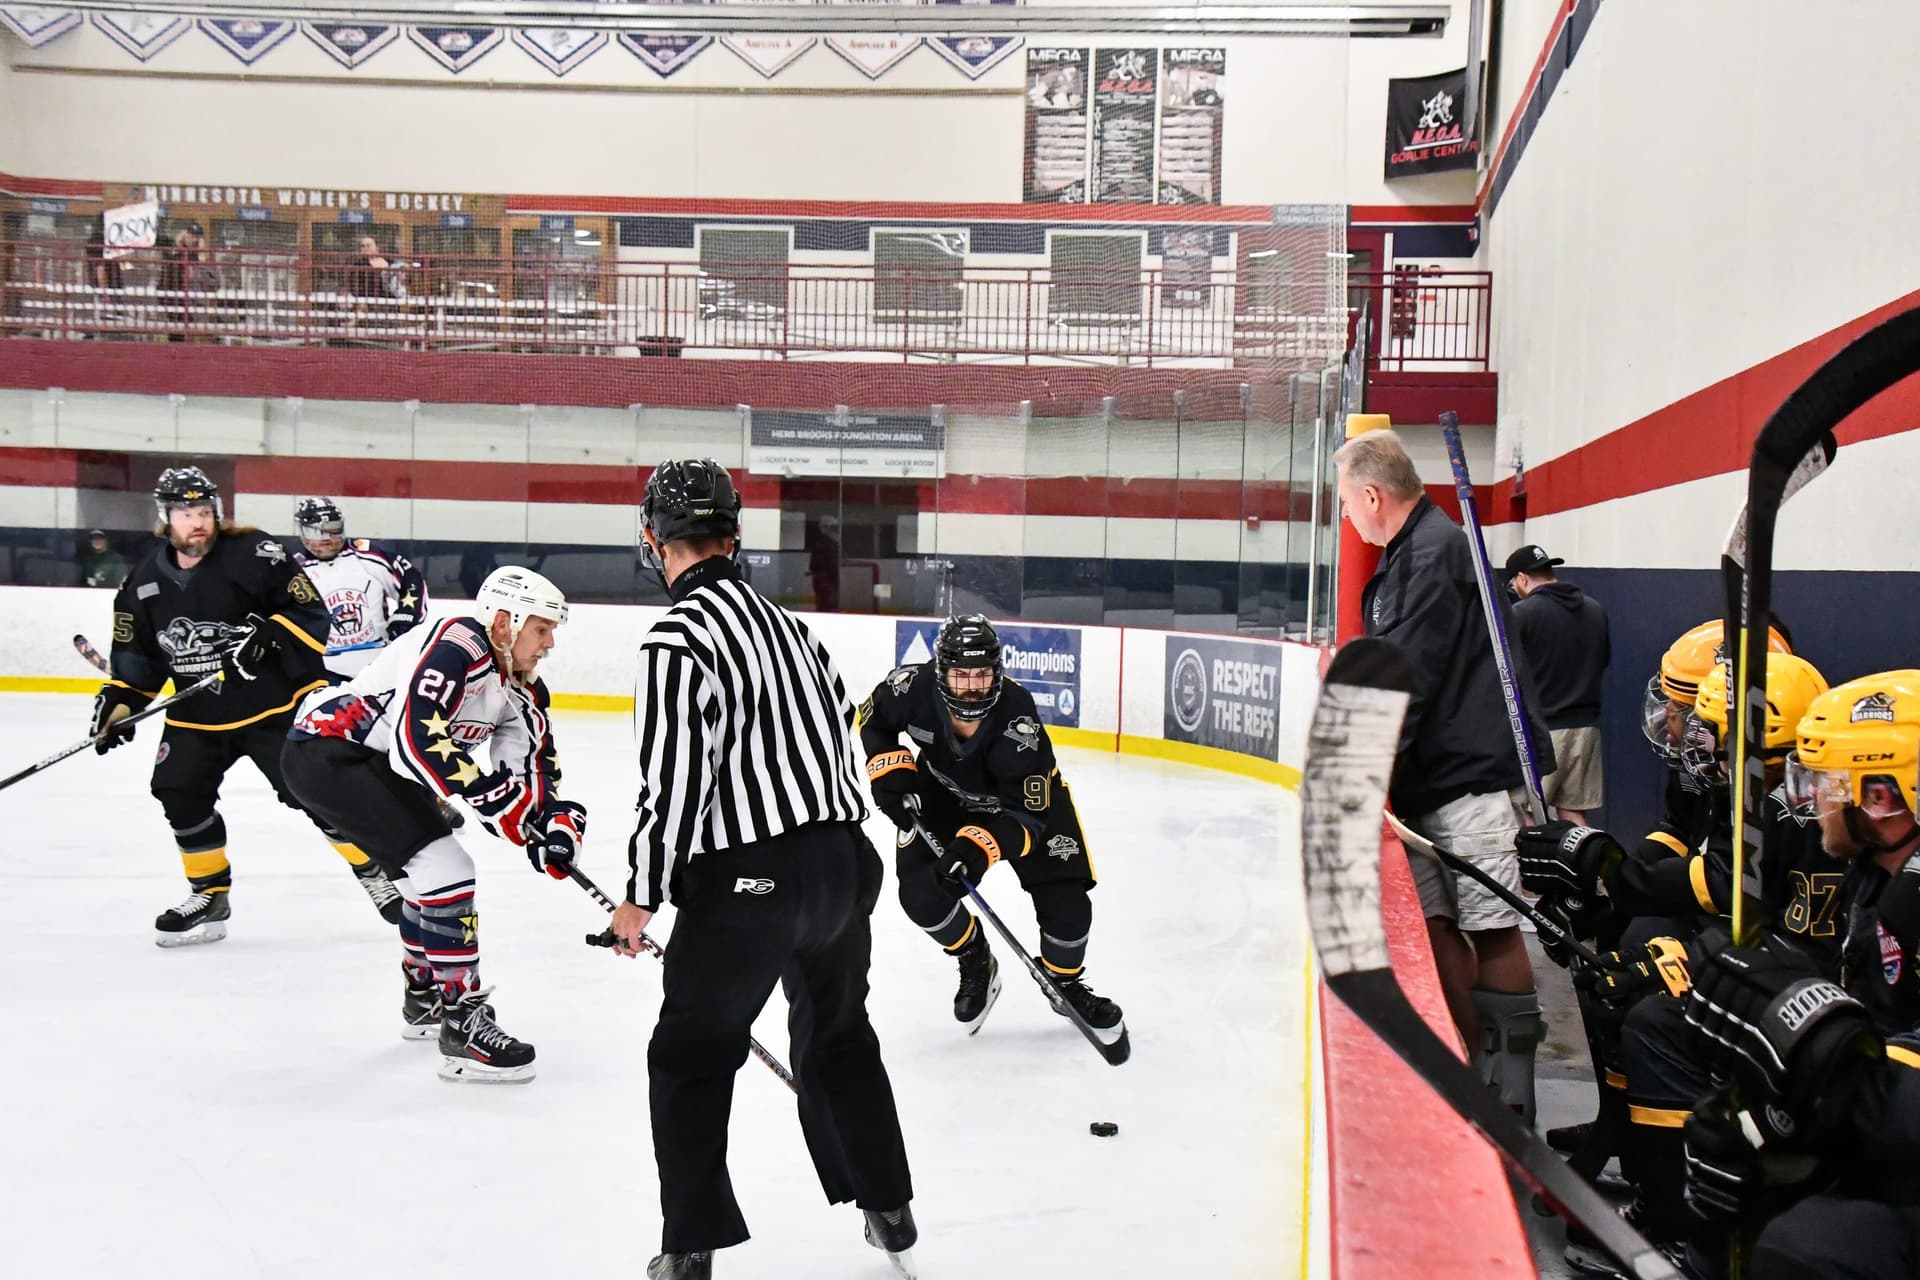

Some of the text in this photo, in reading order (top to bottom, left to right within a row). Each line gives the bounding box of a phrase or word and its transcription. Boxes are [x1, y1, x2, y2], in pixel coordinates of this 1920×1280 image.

[1391, 141, 1478, 164] GOALIE CENTR
[278, 190, 370, 209] WOMEN'S
[385, 193, 463, 212] HOCKEY
[772, 430, 923, 442] HERB BROOKS FOUNDATION ARENA
[327, 591, 366, 607] ULSA
[176, 653, 222, 662] PITTSBUR
[1002, 644, 1075, 675] Champions
[417, 668, 456, 708] 21
[1212, 658, 1277, 700] RESPECT
[1211, 699, 1275, 740] THE REFS
[1852, 753, 1895, 762] CCM
[1784, 870, 1845, 937] 87
[1532, 910, 1565, 937] CCM
